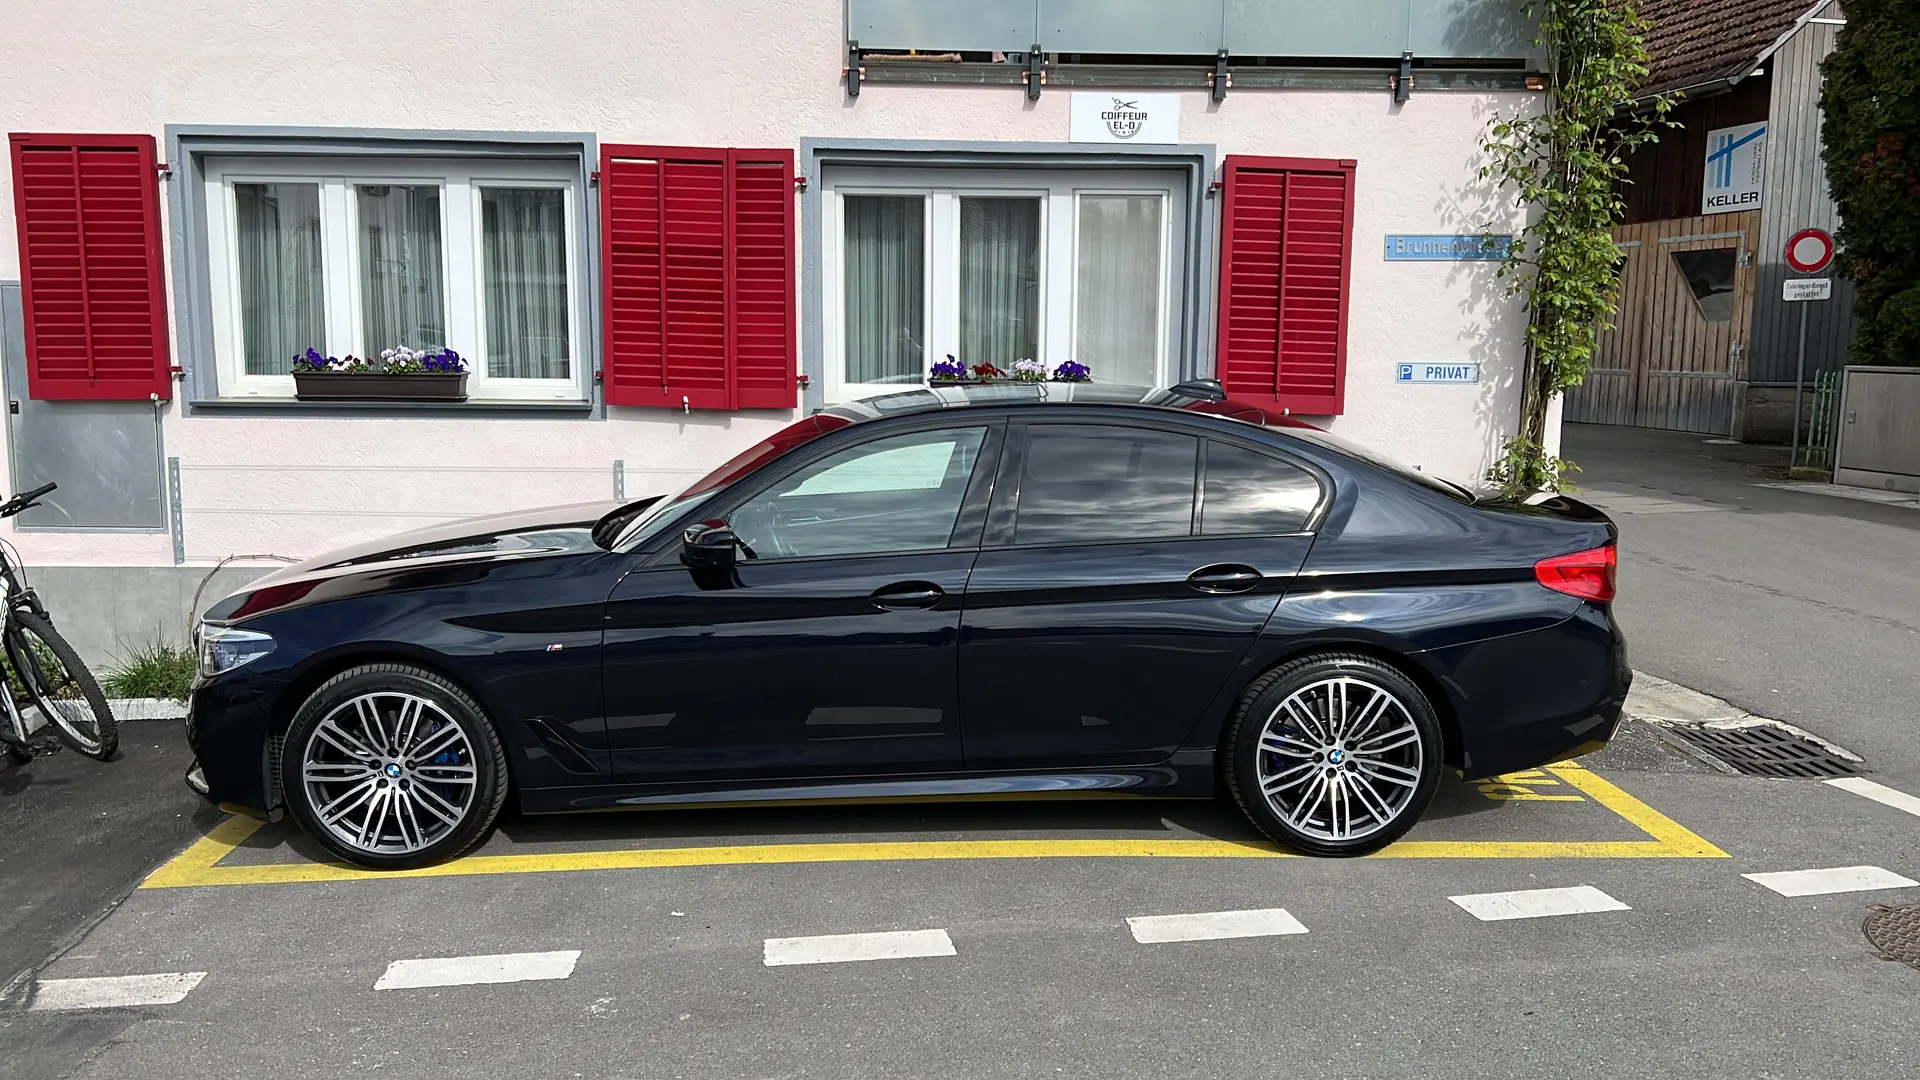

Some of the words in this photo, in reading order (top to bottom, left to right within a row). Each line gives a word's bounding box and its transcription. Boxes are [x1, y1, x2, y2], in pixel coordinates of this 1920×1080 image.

[1101, 111, 1148, 121] COIFFEUR
[1113, 121, 1135, 130] EL-D
[1707, 192, 1759, 207] KELLER
[1401, 366, 1411, 379] P
[1426, 366, 1470, 379] PRIVAT
